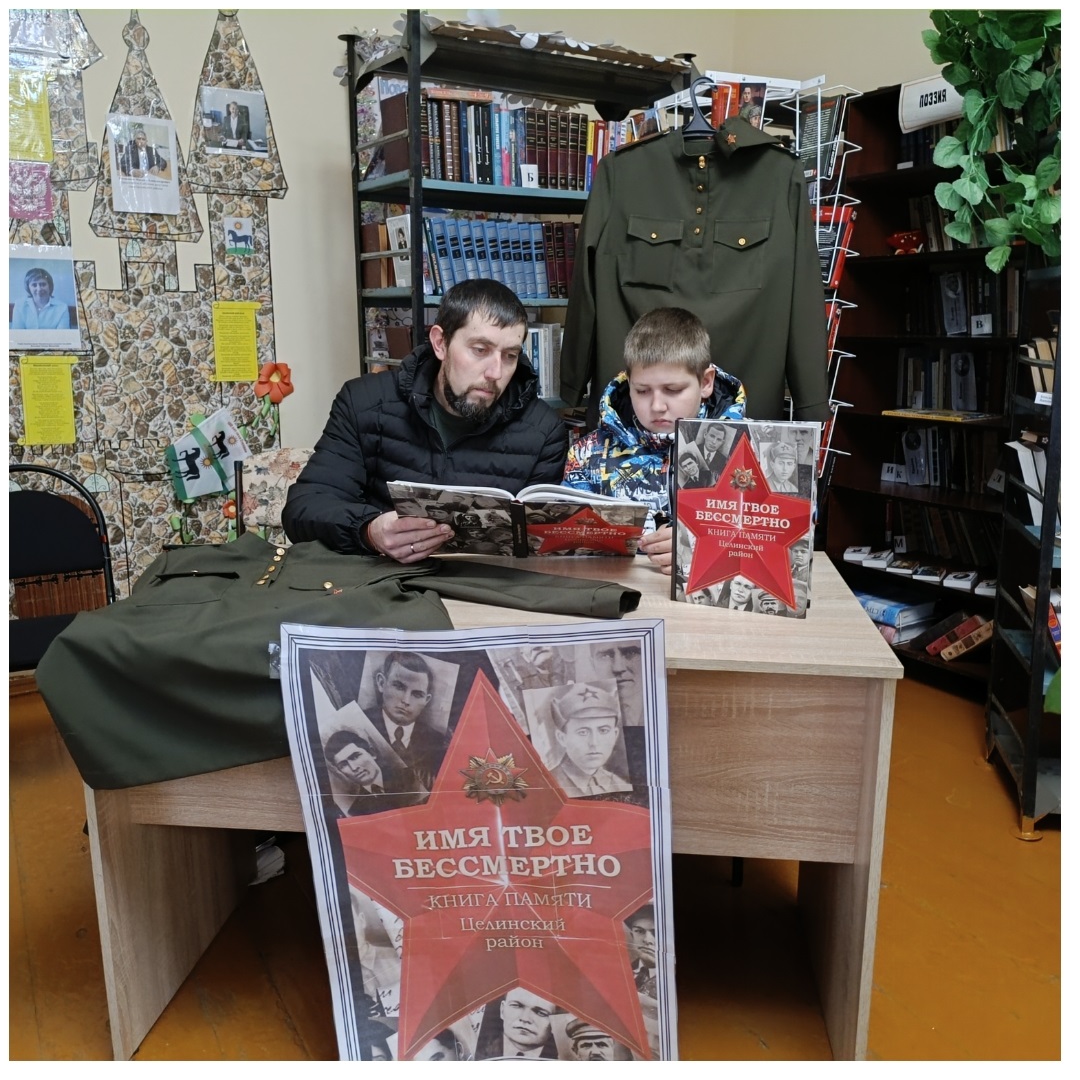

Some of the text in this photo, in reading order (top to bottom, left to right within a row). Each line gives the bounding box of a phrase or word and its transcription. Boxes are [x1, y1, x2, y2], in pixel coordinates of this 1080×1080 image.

[919, 88, 947, 108] ПОЭЗИЯ
[527, 172, 534, 182] Б
[976, 320, 984, 329] В
[886, 466, 894, 474] И
[896, 470, 902, 479] К
[992, 473, 1002, 484] Л
[706, 498, 780, 515] ИМЯ ТВОЕ
[695, 510, 790, 528] БЕССМЕРТНО
[708, 528, 776, 542] КНИГА ПАМЯТИ
[718, 540, 764, 552] Целинский
[894, 538, 904, 548] М
[728, 550, 754, 559] район
[413, 824, 594, 850] ИМЯ ТВОЕ
[392, 853, 622, 879] БЕССМЕРТНО
[428, 892, 593, 909] КНИГА ПАМЯТИ
[460, 916, 566, 933] Целинский
[486, 936, 544, 952] район
